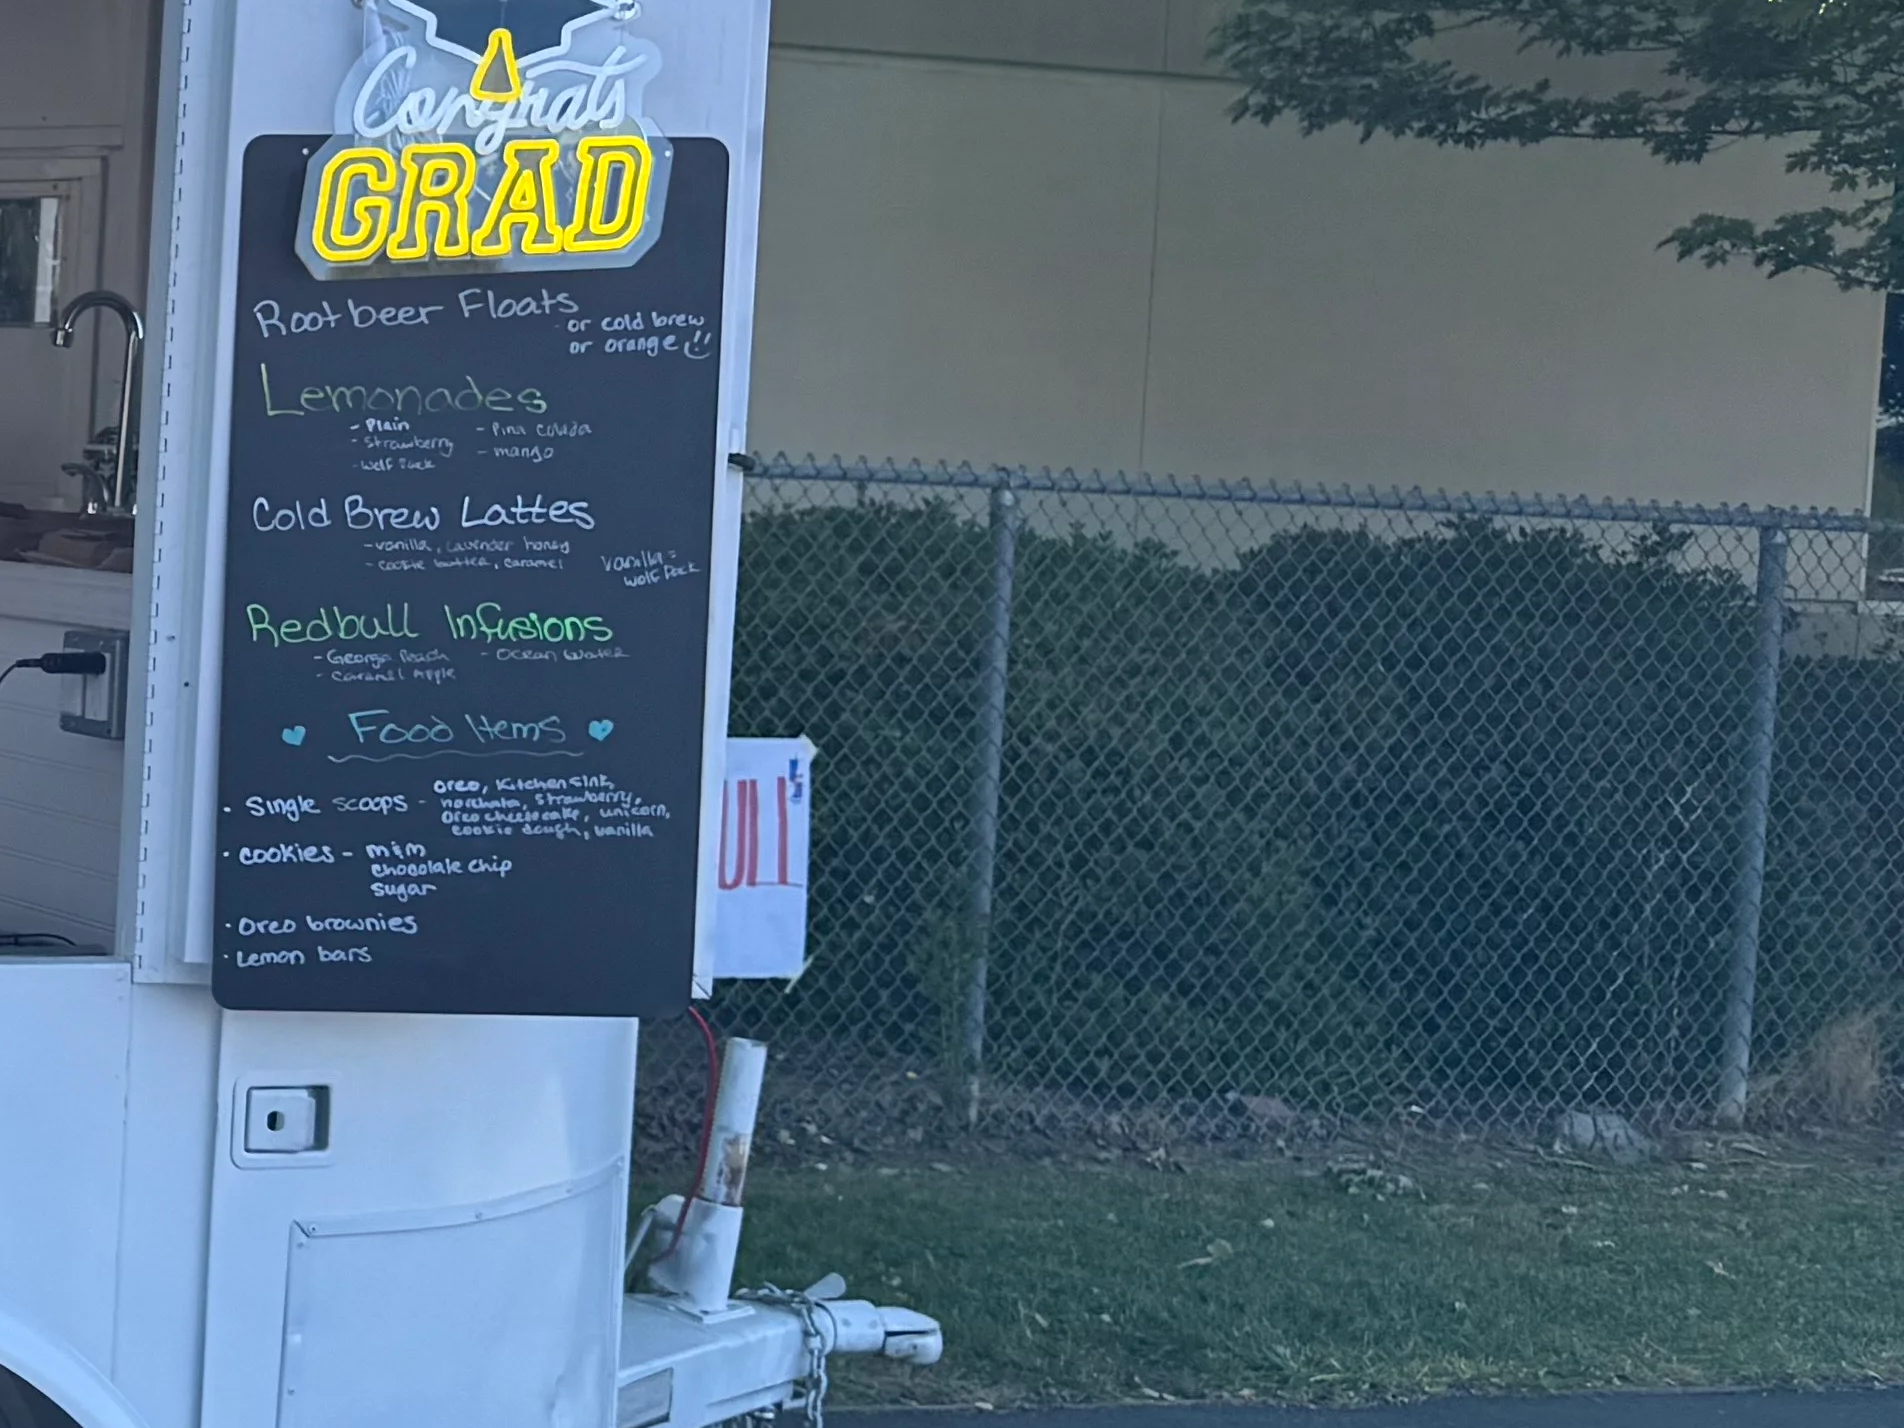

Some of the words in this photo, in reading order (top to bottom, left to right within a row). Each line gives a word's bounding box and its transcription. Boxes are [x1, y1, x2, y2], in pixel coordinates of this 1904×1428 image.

[354, 44, 647, 159] Congrats
[311, 135, 652, 262] GRAD
[458, 288, 580, 319] Floats
[567, 319, 591, 333] or
[601, 312, 644, 331] cold
[652, 311, 705, 328] brew
[569, 342, 592, 354] or
[604, 335, 678, 357] orange
[259, 363, 549, 417] Lemonades
[365, 416, 410, 432] Plain
[493, 445, 554, 463] mango
[252, 496, 332, 532] Cold
[345, 494, 440, 532] Brew
[460, 494, 595, 531] Lattes
[246, 602, 419, 647] Redbull
[444, 602, 613, 644] Infusions
[348, 709, 453, 745] Food
[464, 714, 567, 745] Items
[246, 795, 322, 822] Single
[332, 794, 408, 815] scoops
[239, 843, 335, 865] cookies
[370, 882, 437, 903] sugar
[238, 916, 297, 936] Oreo
[306, 912, 418, 934] brownies
[237, 950, 306, 968] Lemon
[317, 945, 373, 963] bars
